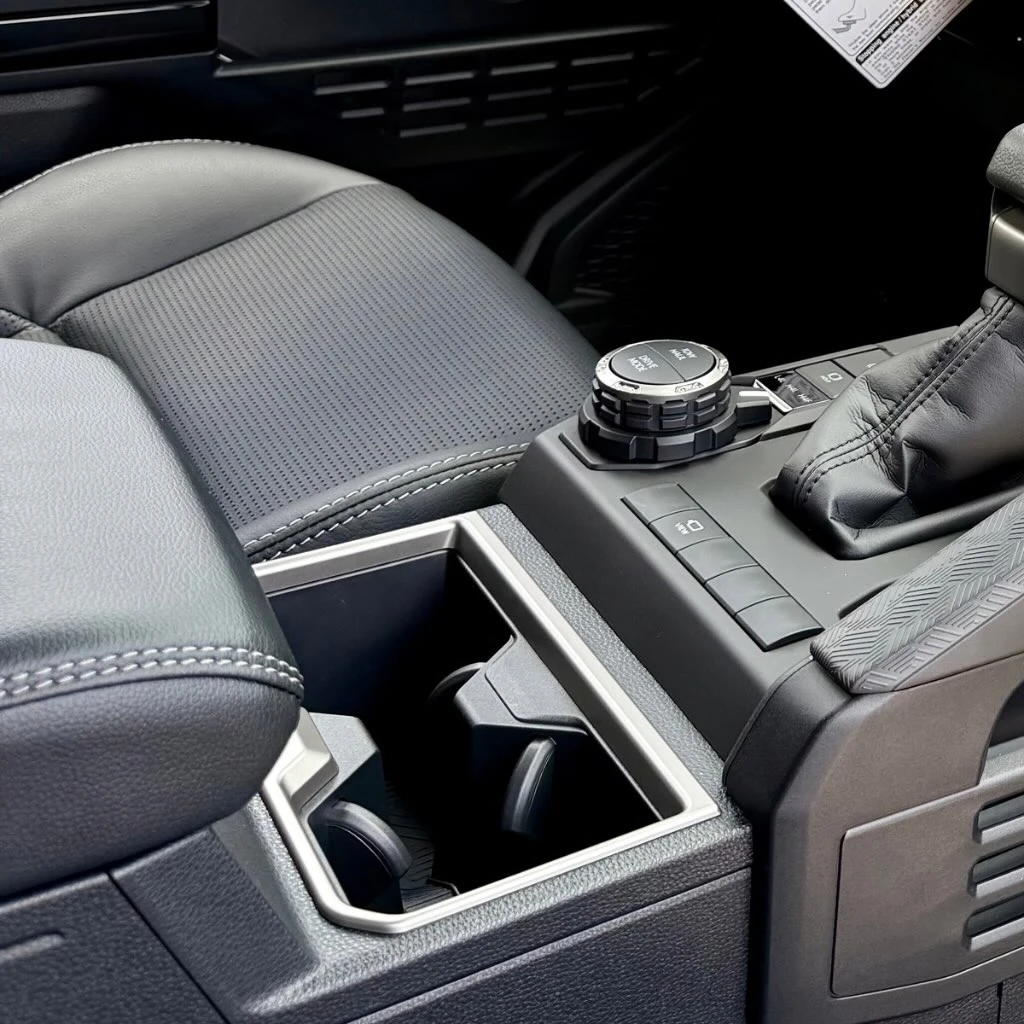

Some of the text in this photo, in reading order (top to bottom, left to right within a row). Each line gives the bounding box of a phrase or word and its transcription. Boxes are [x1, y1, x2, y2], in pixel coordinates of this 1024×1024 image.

[857, 37, 883, 61] Stopping
[626, 357, 648, 373] MODE
[638, 354, 659, 369] DRIVE
[674, 522, 690, 535] VIEW
